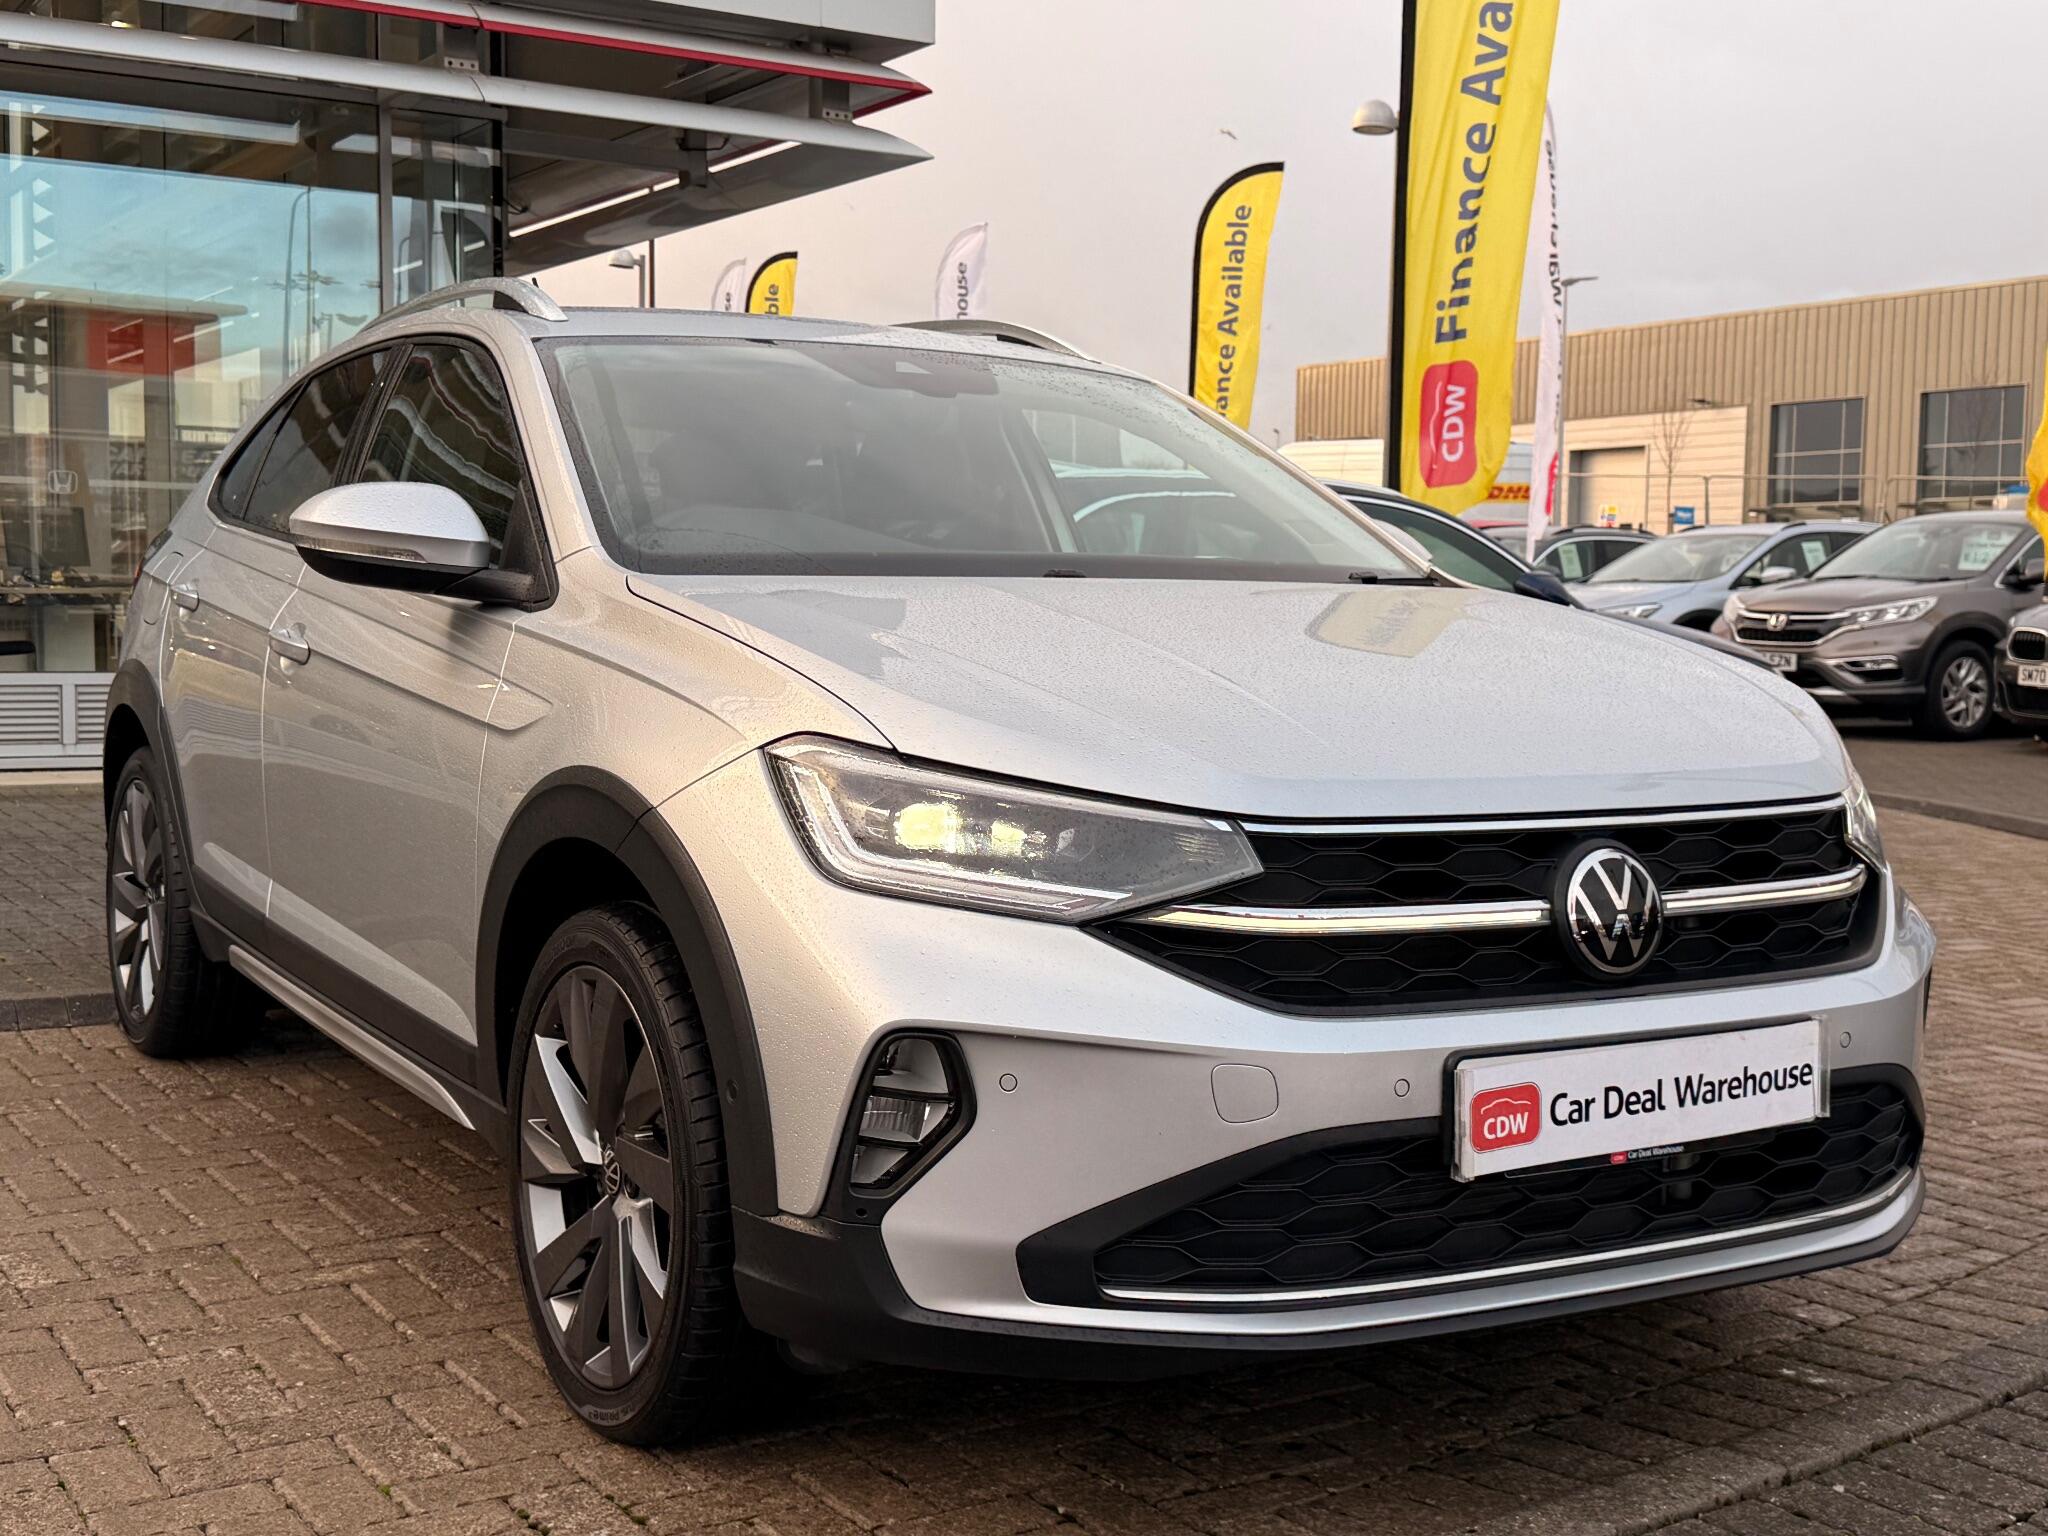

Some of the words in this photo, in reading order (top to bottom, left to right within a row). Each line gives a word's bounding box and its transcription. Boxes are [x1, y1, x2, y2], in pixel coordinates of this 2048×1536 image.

[1217, 204, 1253, 337] Available
[1435, 122, 1497, 344] Finance
[1216, 344, 1236, 417] ance
[1441, 384, 1467, 462] CDW
[1483, 1111, 1529, 1141] CDW
[1550, 1092, 1596, 1127] Car
[1604, 1078, 1666, 1119] Deal
[1674, 1062, 1813, 1108] Warehouse
